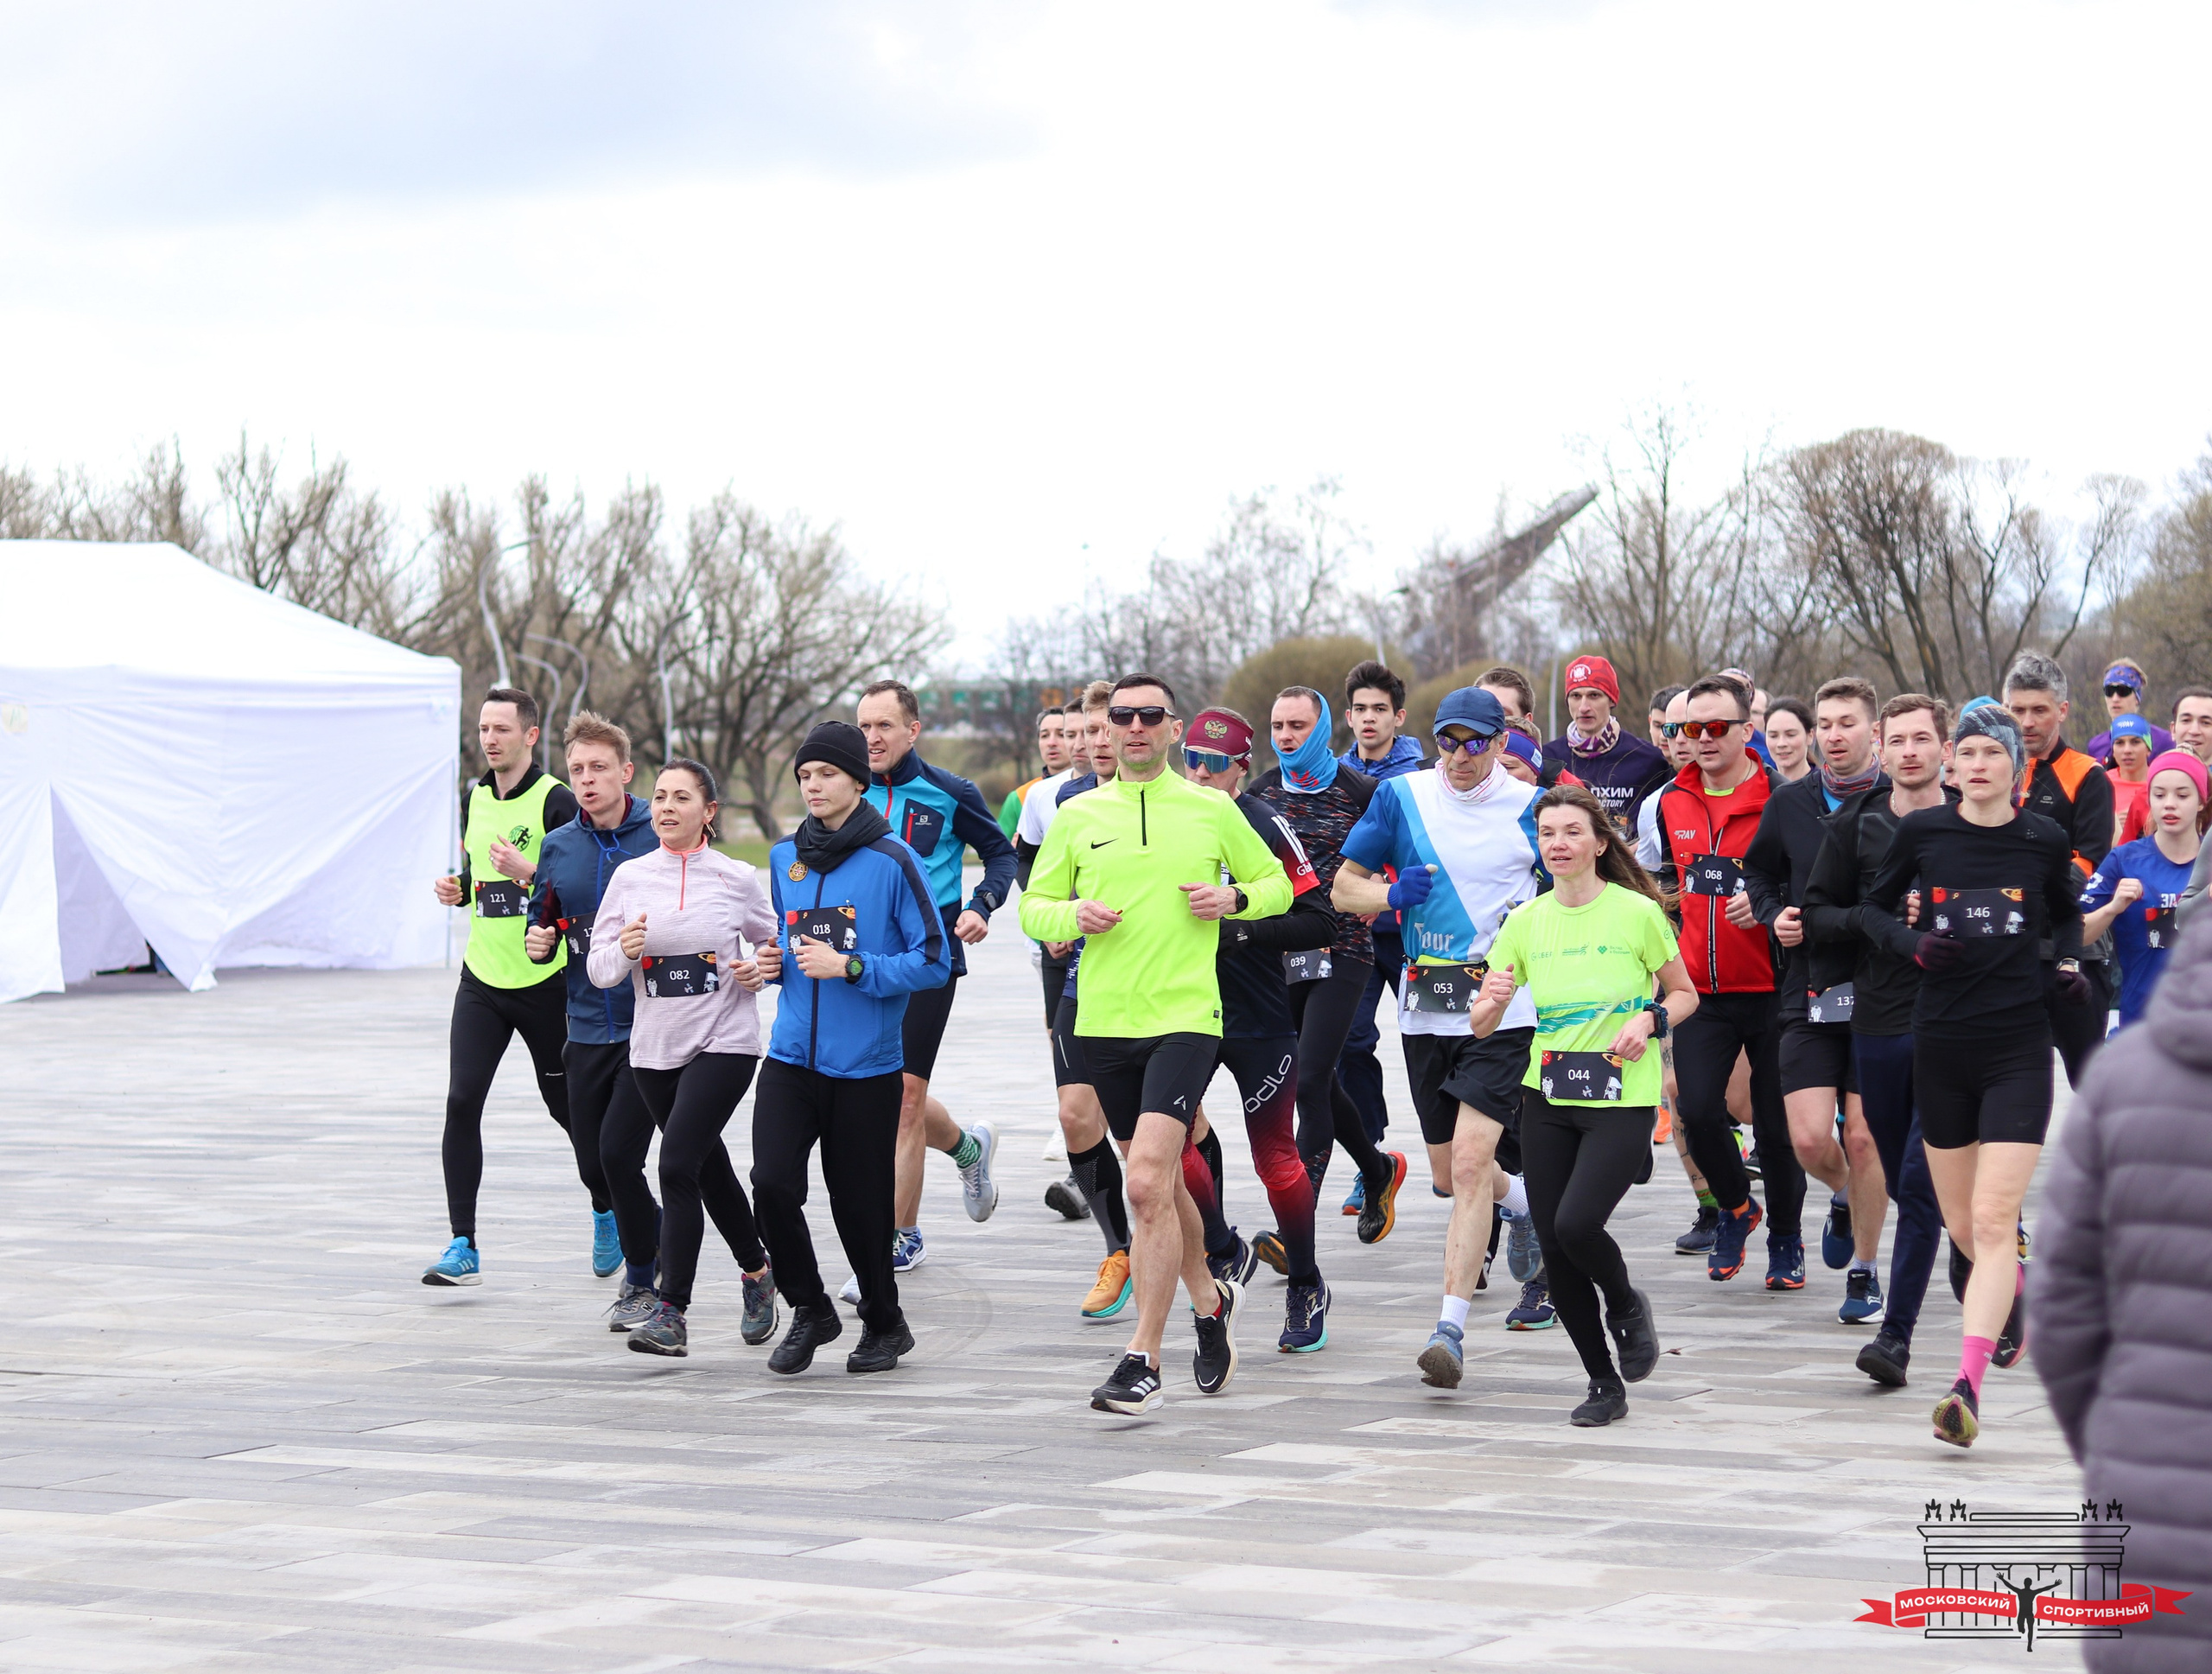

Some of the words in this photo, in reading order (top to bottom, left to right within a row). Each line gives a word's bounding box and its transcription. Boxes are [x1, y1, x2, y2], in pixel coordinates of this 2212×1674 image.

[1705, 869, 1722, 880] 068
[490, 893, 506, 903] 121
[1967, 907, 1990, 919] 146
[812, 923, 831, 935] 018
[1290, 956, 1306, 968] 039
[669, 970, 690, 980] 082
[1433, 983, 1453, 994] 053
[1567, 1069, 1591, 1081] 044
[1244, 1054, 1293, 1113] odlo
